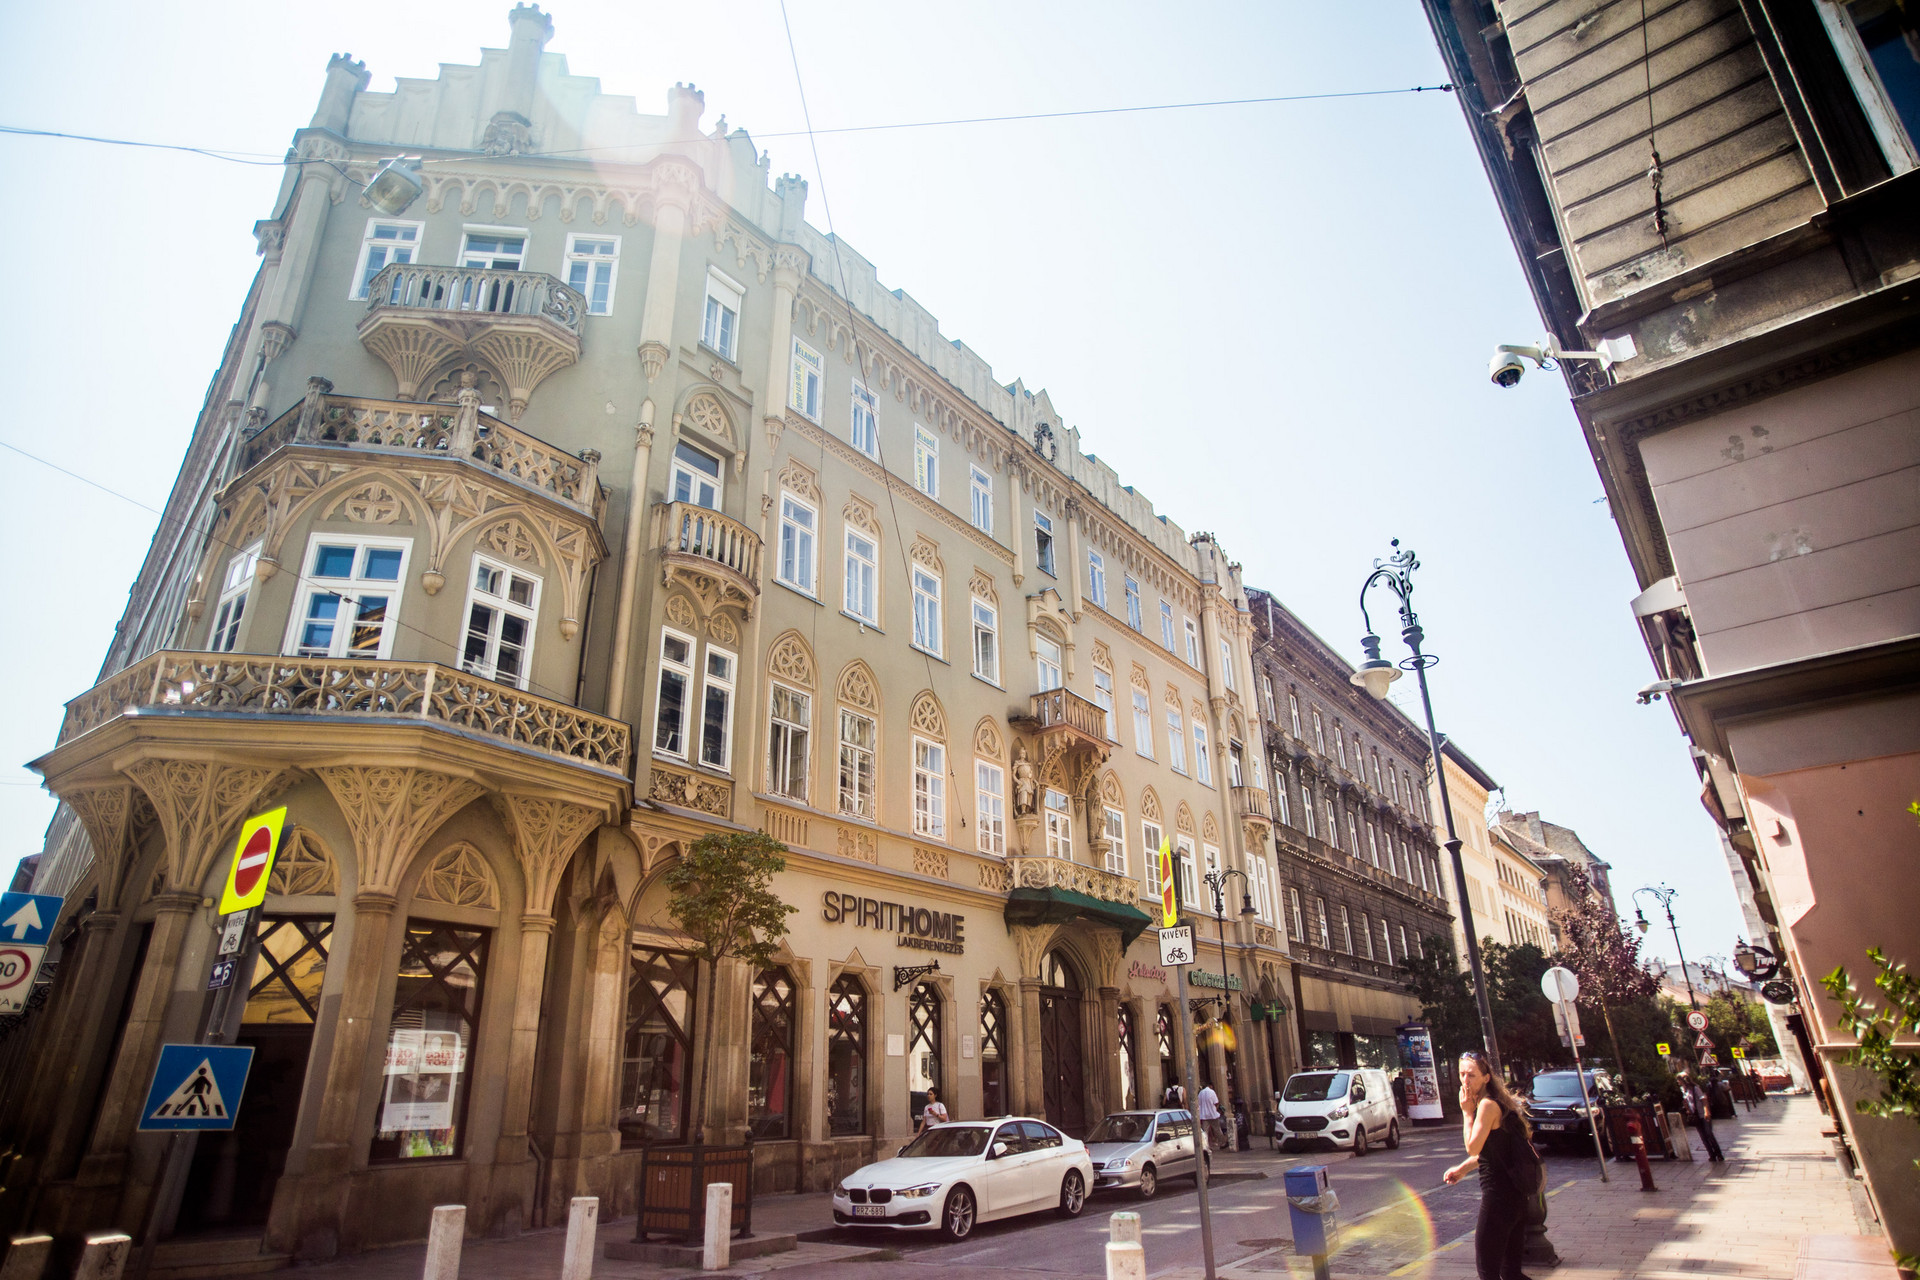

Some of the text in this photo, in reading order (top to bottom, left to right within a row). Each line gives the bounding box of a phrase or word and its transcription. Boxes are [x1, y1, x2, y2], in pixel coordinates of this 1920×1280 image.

[822, 891, 965, 942] SPIRITHOME
[1161, 928, 1189, 940] KIVÉVE
[1692, 1017, 1703, 1026] 30
